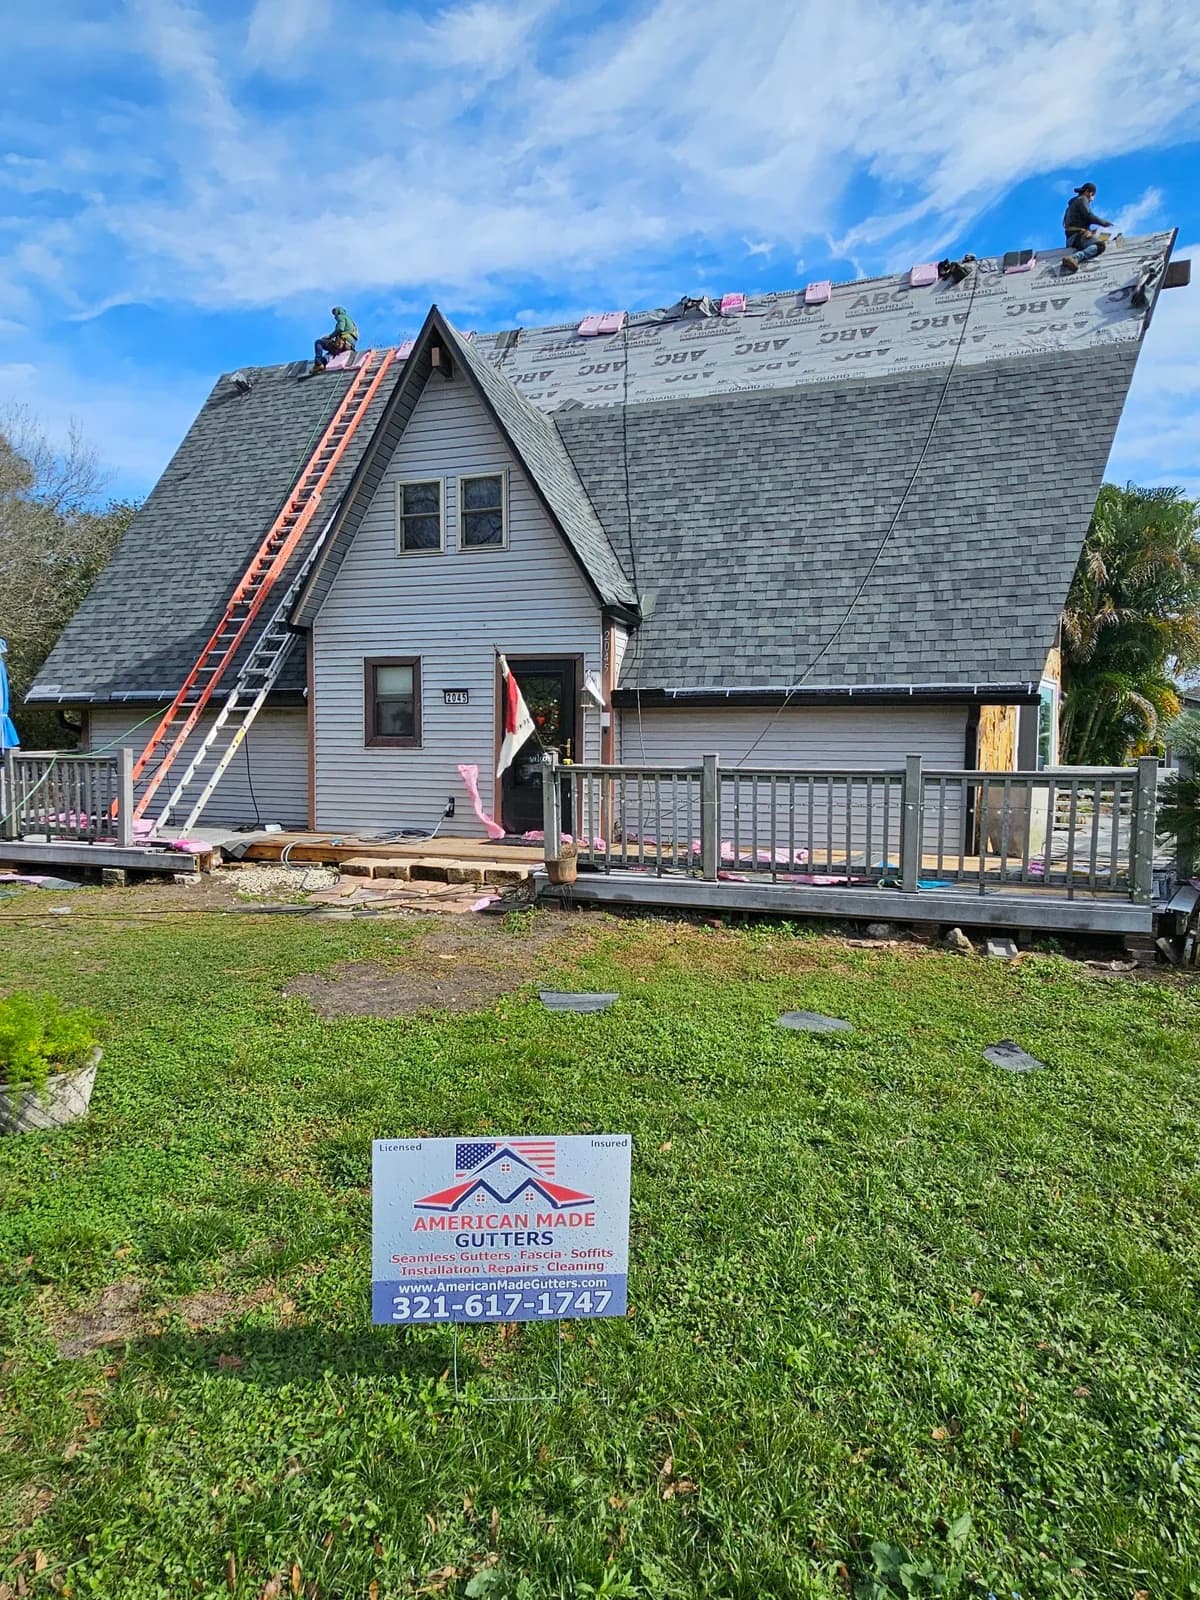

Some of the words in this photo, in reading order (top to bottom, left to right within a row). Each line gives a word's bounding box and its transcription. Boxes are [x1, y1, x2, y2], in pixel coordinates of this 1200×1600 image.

[848, 290, 909, 310] ABC
[1005, 297, 1071, 316] ABC
[909, 312, 972, 331] ABC
[820, 327, 878, 344] ABC
[734, 338, 790, 355] ABC
[653, 350, 707, 366] ABC
[578, 360, 627, 377] ABC
[446, 692, 467, 703] 2045
[379, 1143, 422, 1152] Licensed
[591, 1139, 628, 1149] Insured
[413, 1214, 529, 1232] AMERICAN
[536, 1212, 596, 1228] MADE
[455, 1231, 554, 1248] GUTTERS
[391, 1253, 456, 1264] Seamless
[460, 1251, 511, 1262] Gutters
[520, 1250, 562, 1260] Fascia
[571, 1248, 614, 1259] Soffits
[401, 1265, 480, 1276] Installation
[488, 1263, 539, 1275] Repairs
[547, 1262, 604, 1275] Cleaning
[399, 1278, 608, 1295] www.AmericanMadeGutters.com
[392, 1291, 613, 1321] 321-617-1747
